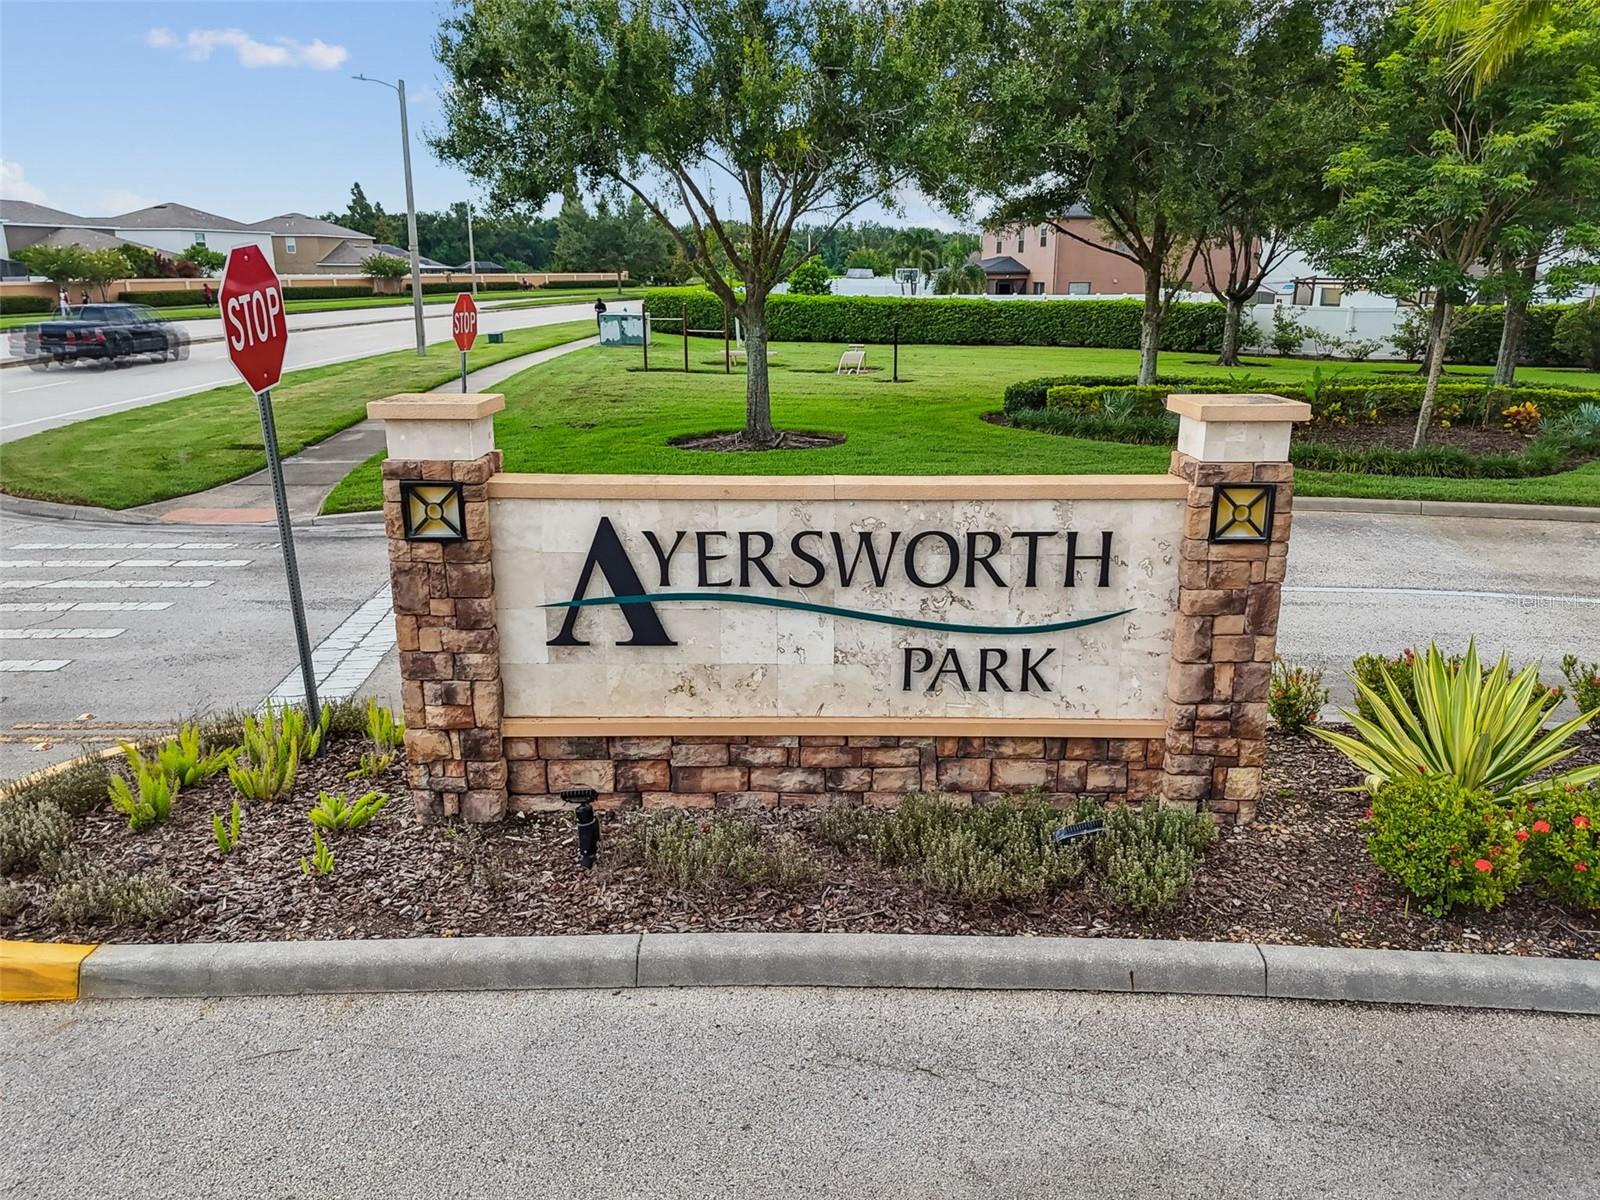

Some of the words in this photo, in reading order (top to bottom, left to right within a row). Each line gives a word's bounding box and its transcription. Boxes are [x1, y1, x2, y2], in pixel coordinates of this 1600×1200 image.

[227, 286, 280, 351] STOP
[454, 311, 476, 335] STOP
[546, 517, 1112, 646] AYERSWORTH
[903, 648, 1057, 692] PARK
